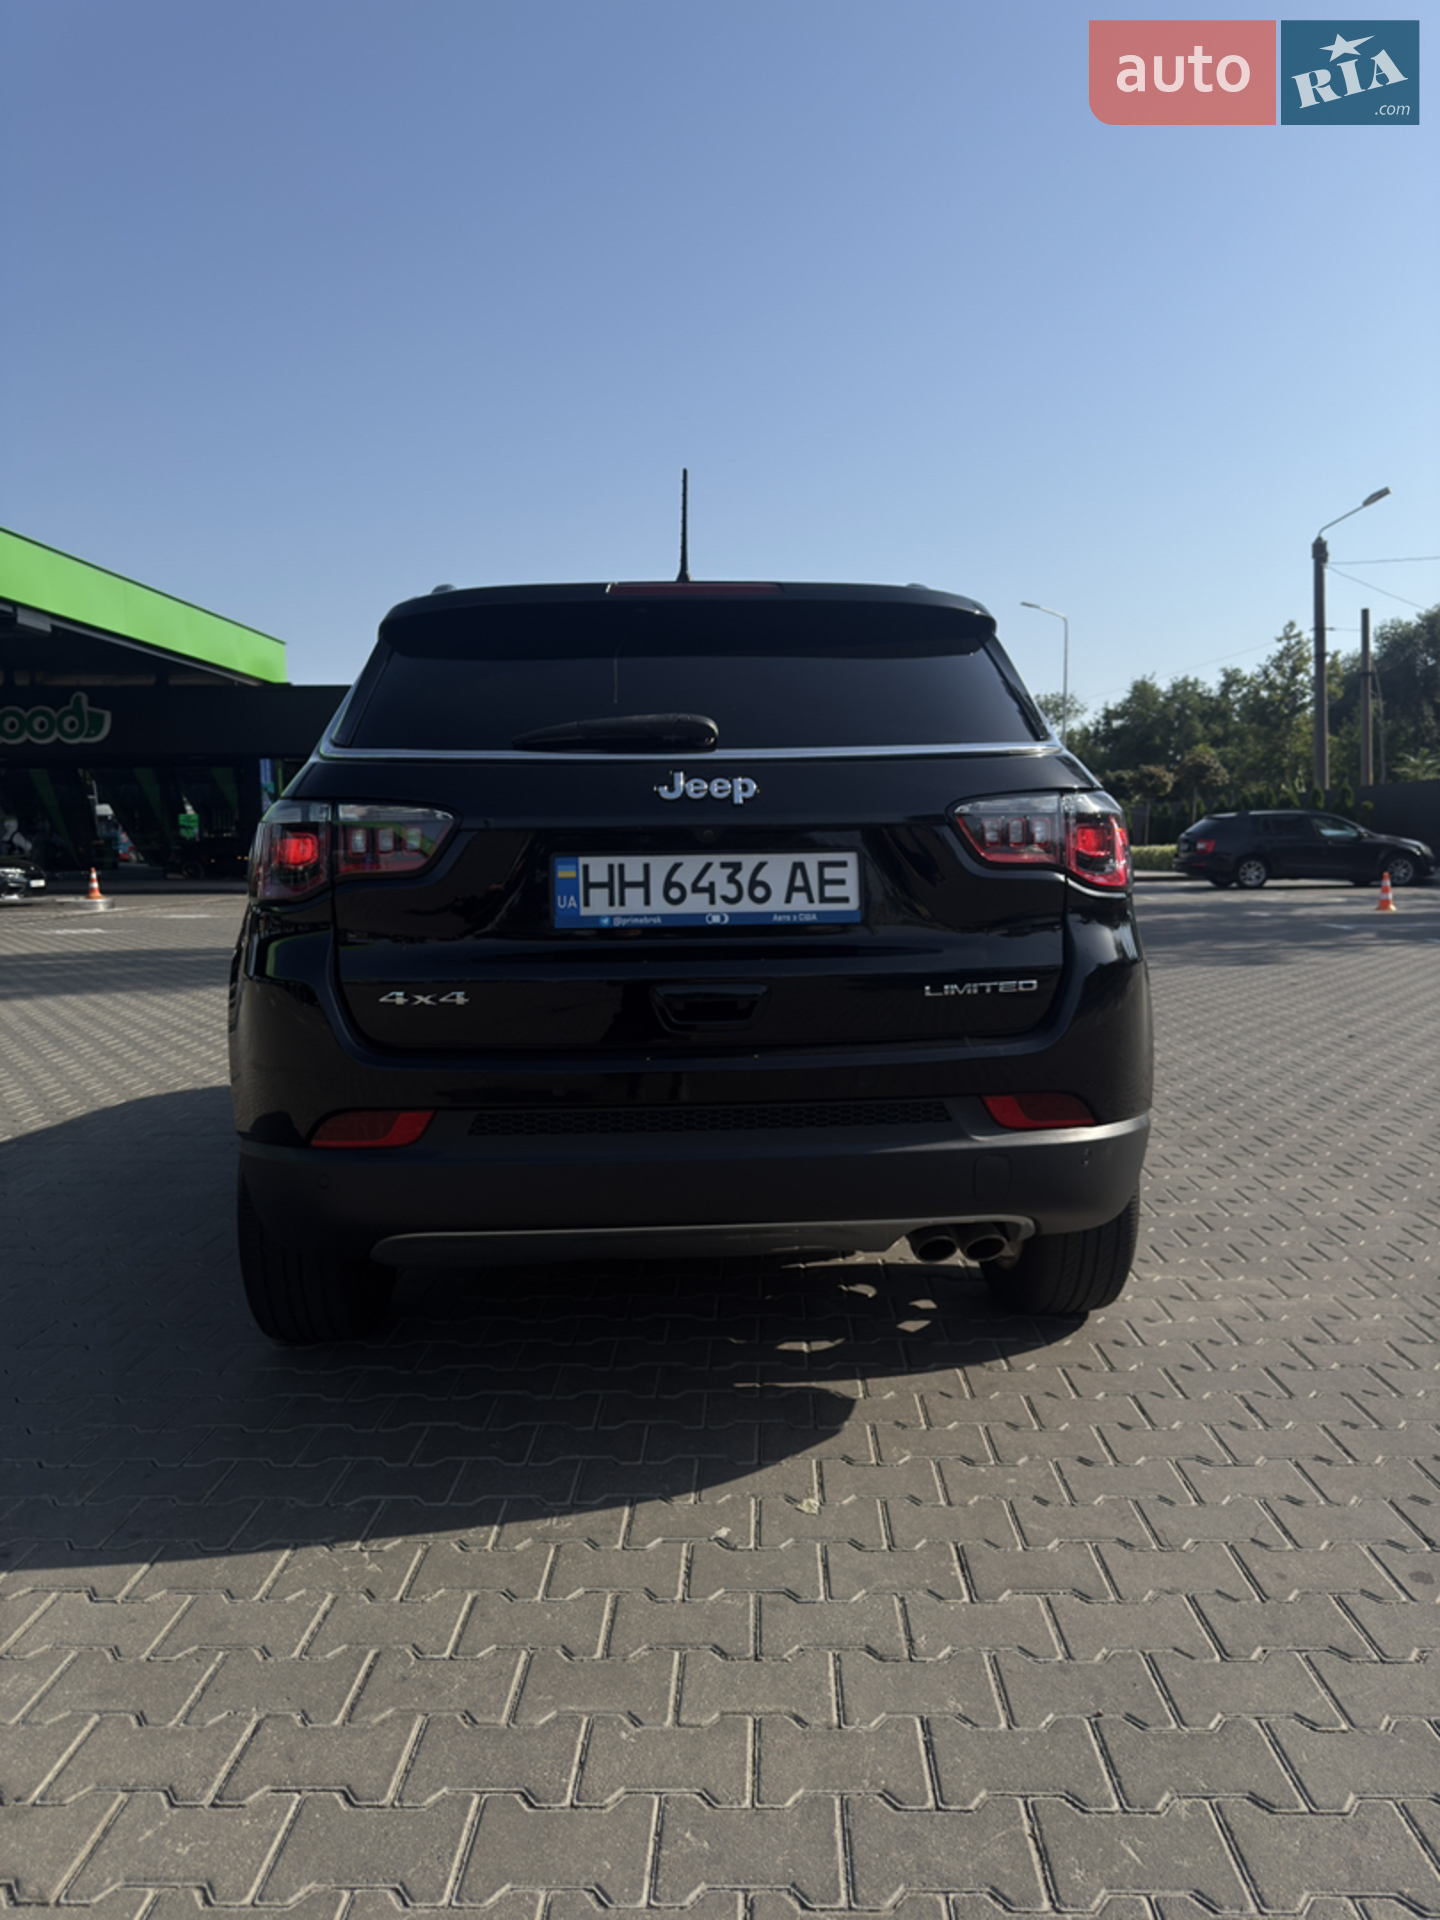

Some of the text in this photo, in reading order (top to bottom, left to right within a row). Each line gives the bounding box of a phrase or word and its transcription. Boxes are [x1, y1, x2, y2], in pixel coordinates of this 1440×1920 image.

[655, 771, 758, 805] Jeep
[582, 860, 850, 907] HH 6436 AE
[557, 895, 577, 909] UA
[924, 979, 1038, 997] LIMITED
[379, 991, 470, 1006] 4x4
